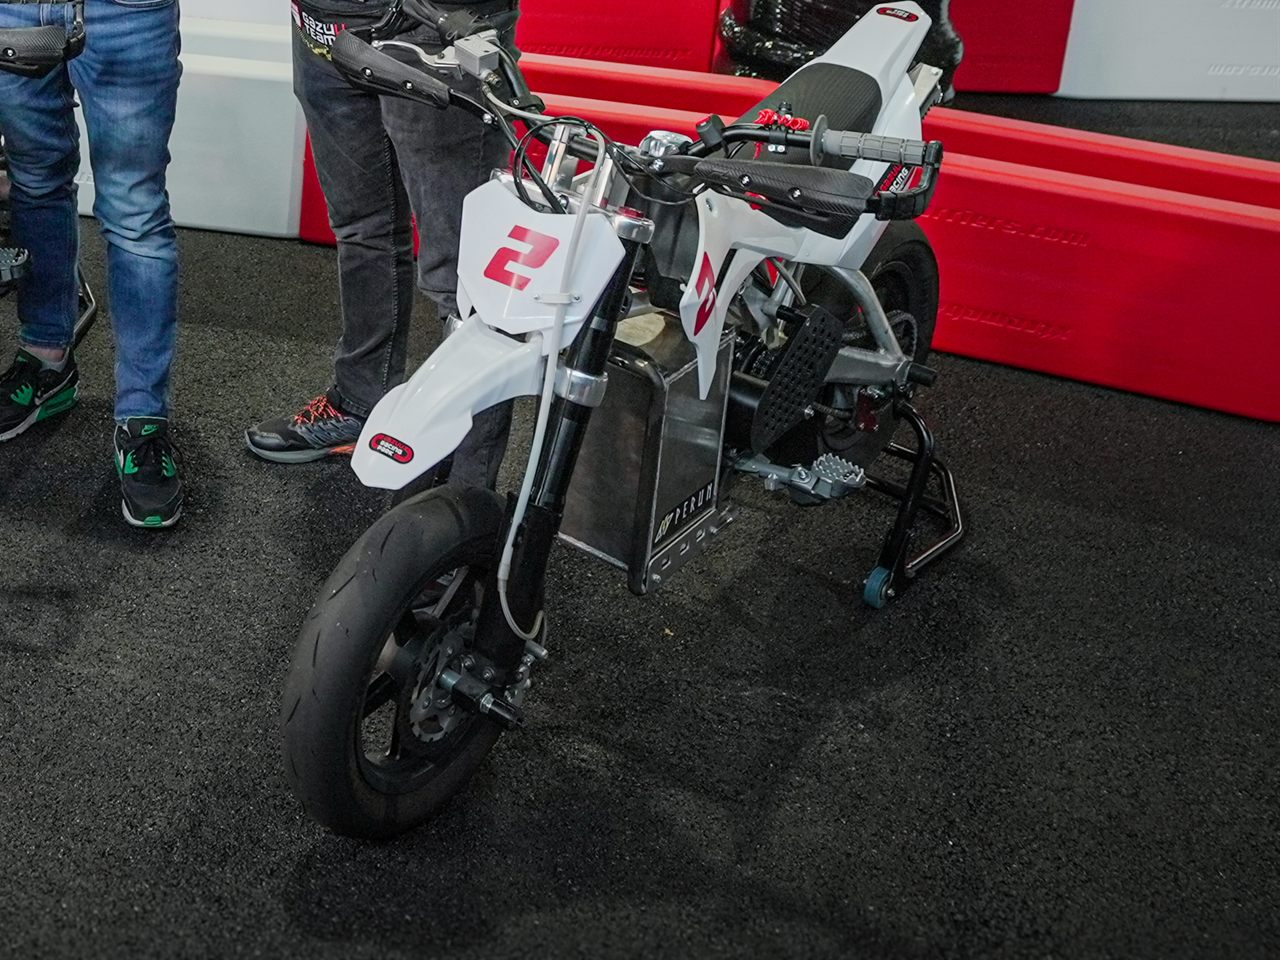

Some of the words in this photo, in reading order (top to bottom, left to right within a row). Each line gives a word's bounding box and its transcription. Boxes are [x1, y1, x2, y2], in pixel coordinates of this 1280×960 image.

[888, 167, 909, 192] ACING
[484, 225, 560, 291] 2
[675, 482, 713, 525] PERUN
